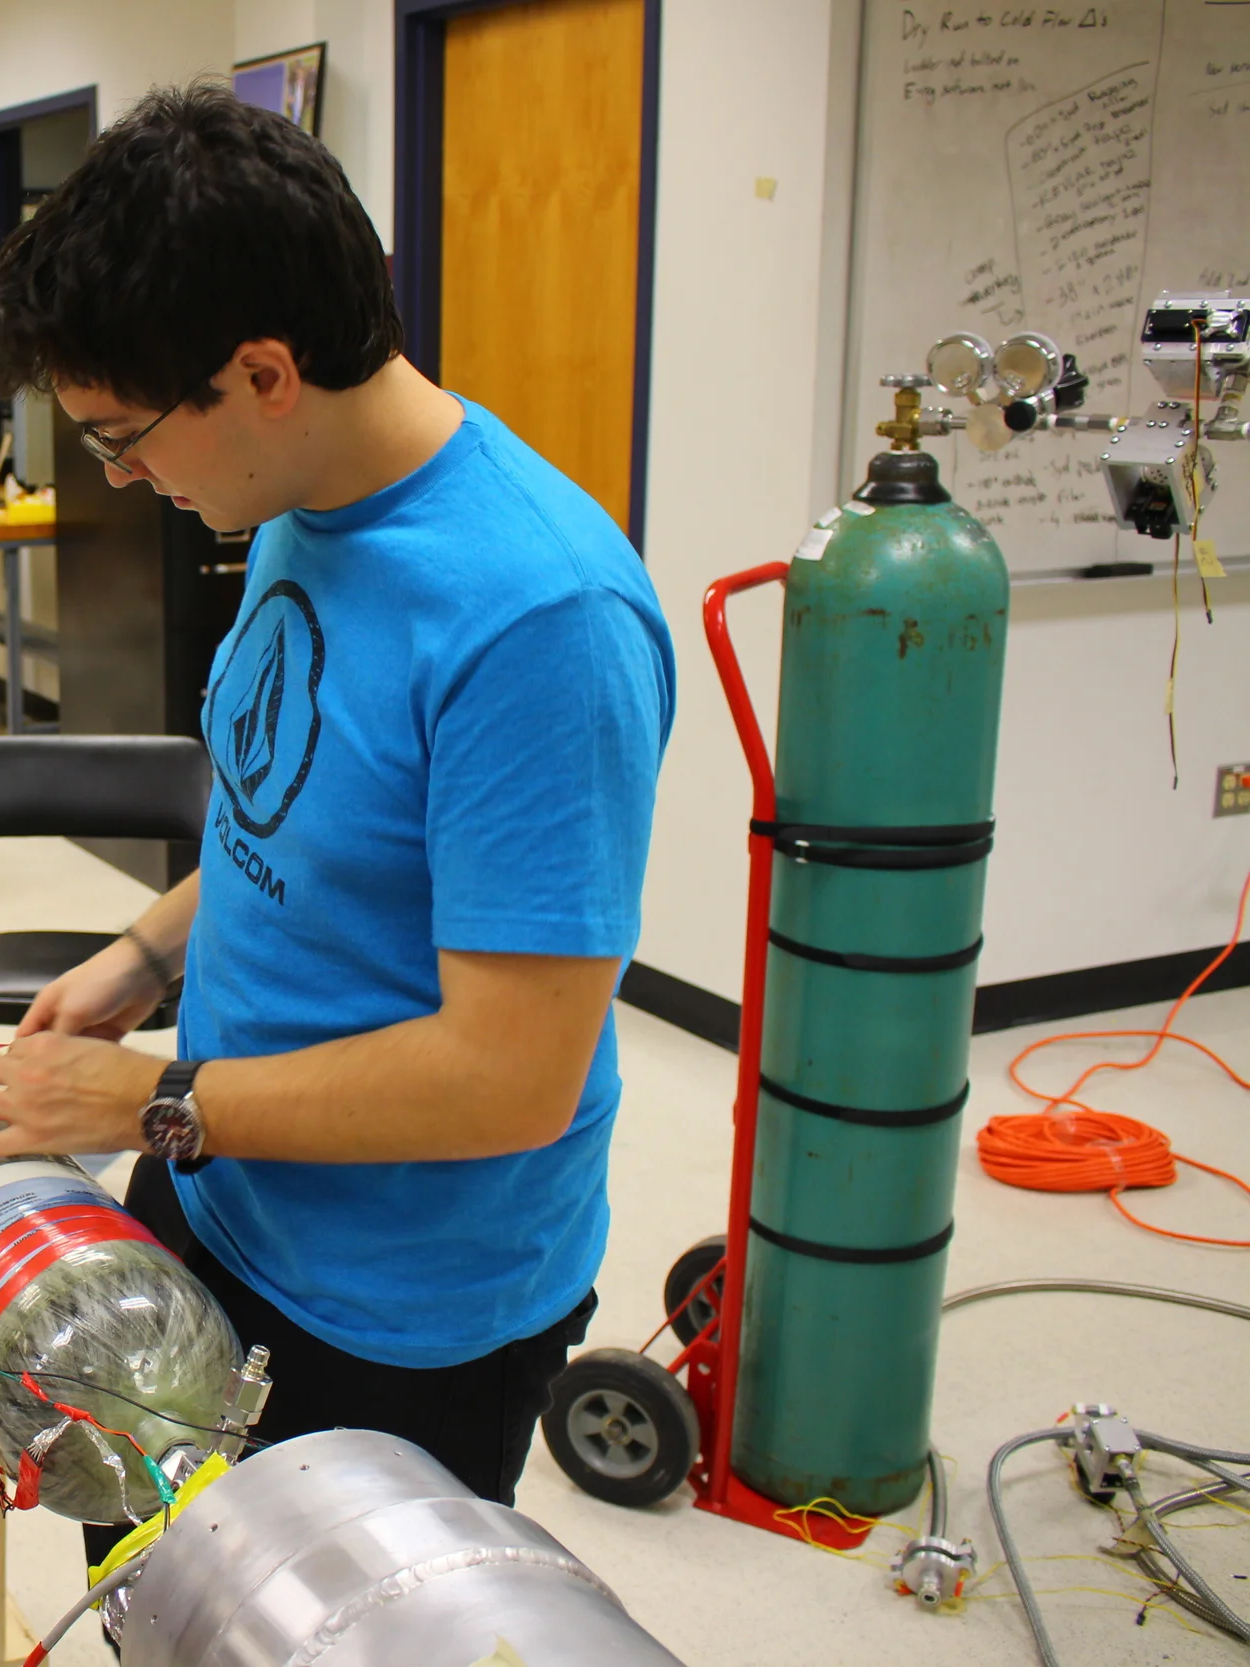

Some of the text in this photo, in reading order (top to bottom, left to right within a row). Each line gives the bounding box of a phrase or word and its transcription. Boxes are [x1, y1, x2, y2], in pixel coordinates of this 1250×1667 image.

[902, 9, 929, 50] Dry
[940, 10, 969, 31] Run
[215, 801, 285, 906] VOLCOM
